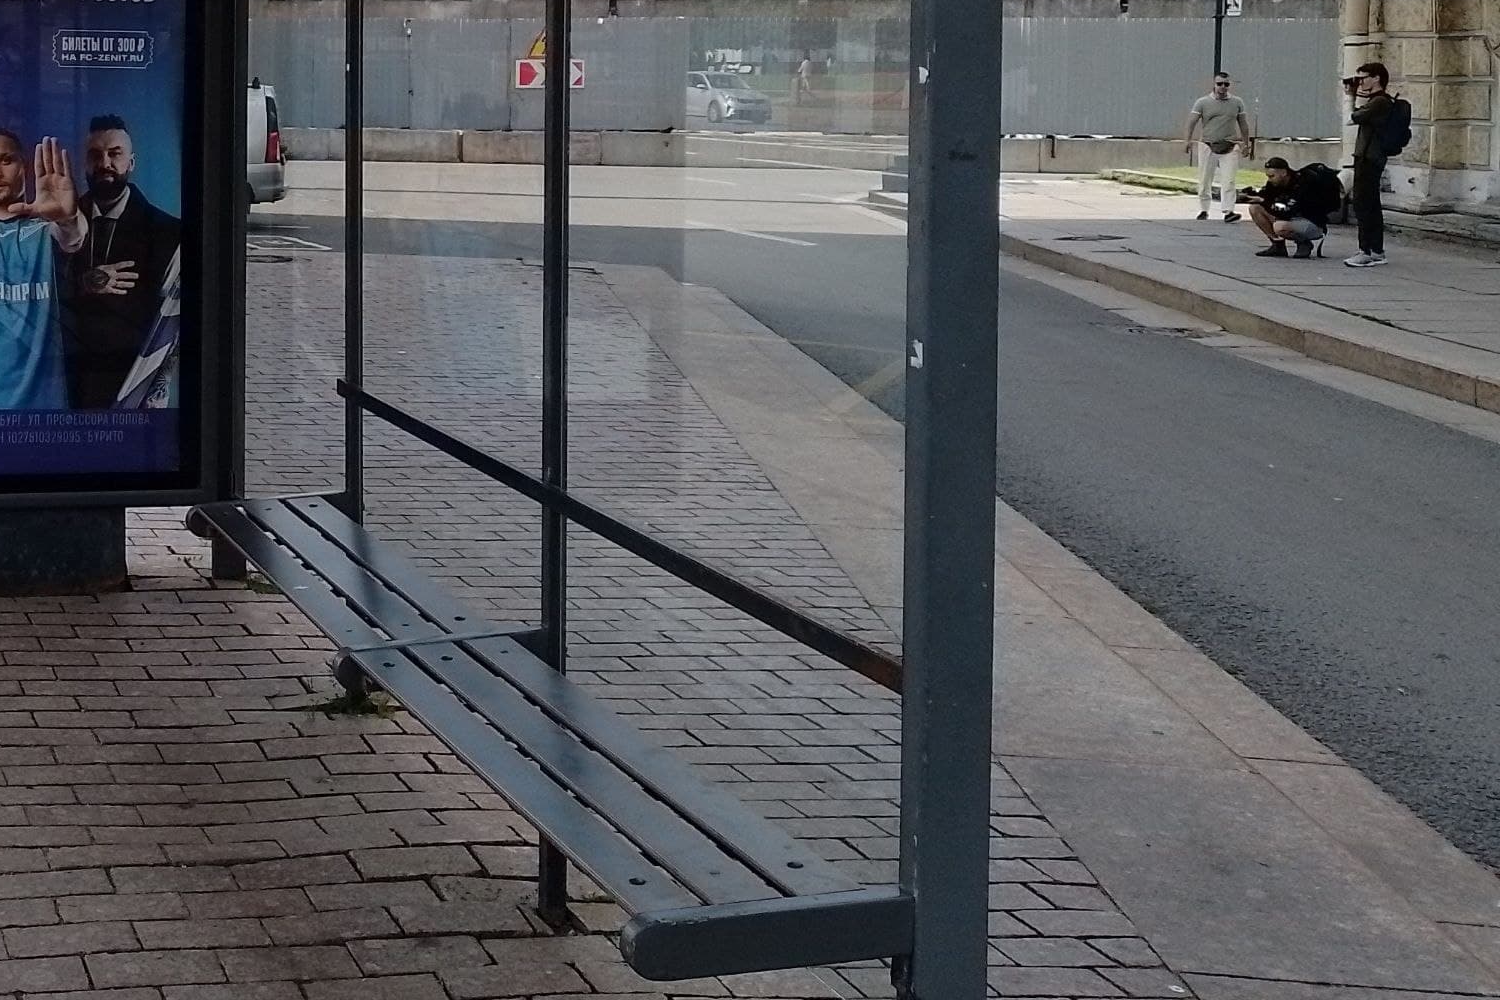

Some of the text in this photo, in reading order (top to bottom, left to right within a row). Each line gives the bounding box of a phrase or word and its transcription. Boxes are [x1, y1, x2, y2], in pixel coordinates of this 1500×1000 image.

[61, 36, 100, 52] БИЛЕТЫ
[102, 37, 115, 52] ОТ
[117, 37, 136, 52] 300
[61, 53, 144, 62] НА FC-ZENIT.RU
